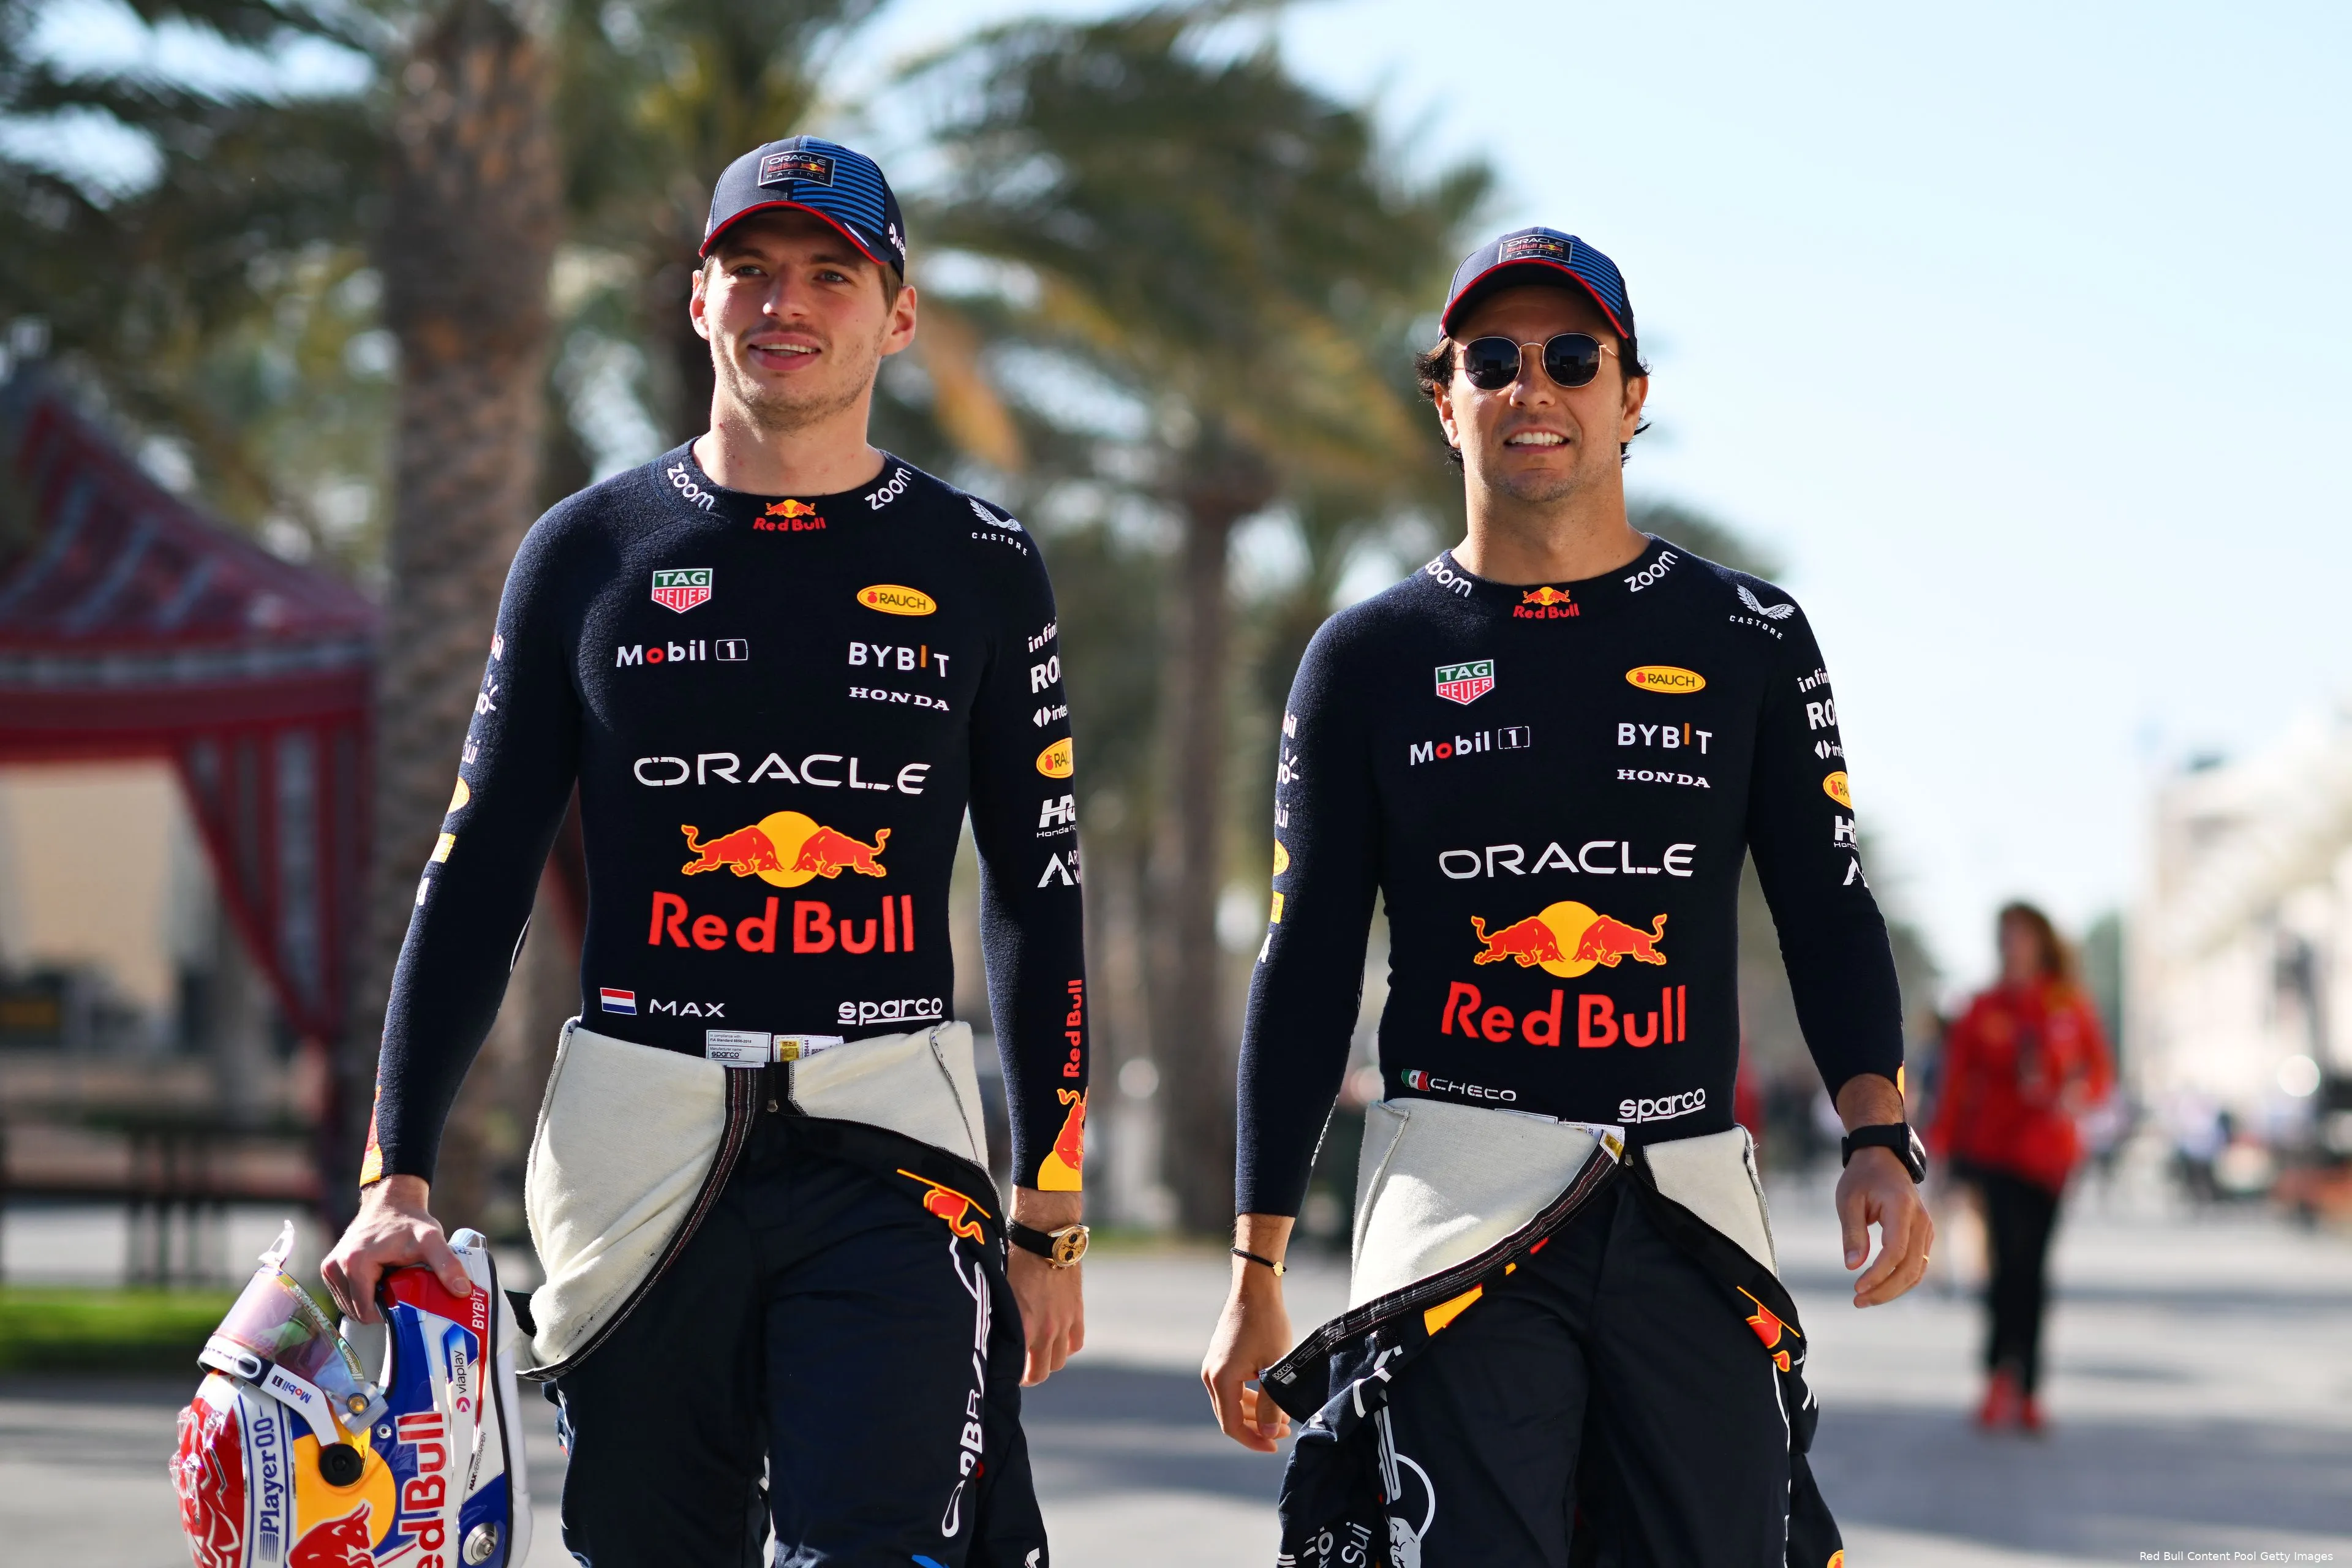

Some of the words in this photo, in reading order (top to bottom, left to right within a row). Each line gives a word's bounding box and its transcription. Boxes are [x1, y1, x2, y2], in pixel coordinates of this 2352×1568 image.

[767, 162, 783, 172] Red
[769, 154, 826, 166] ORACLE
[766, 171, 825, 180] RACING
[1507, 238, 1564, 247] ORACLE
[667, 462, 715, 511] zoom
[864, 467, 912, 511] zoom
[753, 517, 790, 531] Red
[792, 517, 826, 531] Bull
[971, 532, 1027, 556] CASTORE
[658, 571, 707, 586] TAG
[1624, 551, 1678, 592] zoom
[655, 588, 707, 611] HEUER
[879, 592, 926, 611] RAUCH
[1513, 605, 1545, 619] Red
[1548, 604, 1580, 618] Bull
[1729, 615, 1783, 639] CASTORE
[616, 640, 706, 667] Mobil
[848, 642, 949, 677] BYBIT
[1030, 652, 1061, 693] RO
[1440, 663, 1488, 680] TAG
[1648, 673, 1695, 688] RAUCH
[849, 687, 950, 710] HONDA
[1439, 679, 1491, 703] HEUER
[1410, 731, 1490, 766] Mobil
[1618, 723, 1713, 754] BYBIT
[634, 753, 931, 794] ORACLE
[1617, 769, 1711, 788] HONDA
[1036, 826, 1069, 838] Honda
[1439, 841, 1696, 879] ORACLE
[648, 891, 779, 953] Red
[793, 895, 914, 954] Bull
[649, 998, 725, 1018] MAX
[838, 997, 943, 1026] sparco
[1066, 979, 1083, 1027] Bull
[1441, 981, 1564, 1047] Red
[1578, 985, 1686, 1047] Bull
[1063, 1031, 1081, 1077] Red
[1430, 1078, 1517, 1101] CHECO
[1617, 1088, 1705, 1123] sparco
[472, 1289, 485, 1330] BYBIT
[454, 1350, 466, 1395] viaplay
[282, 1381, 312, 1404] Mobil
[398, 1413, 447, 1511] Bull
[260, 1450, 284, 1534] Player
